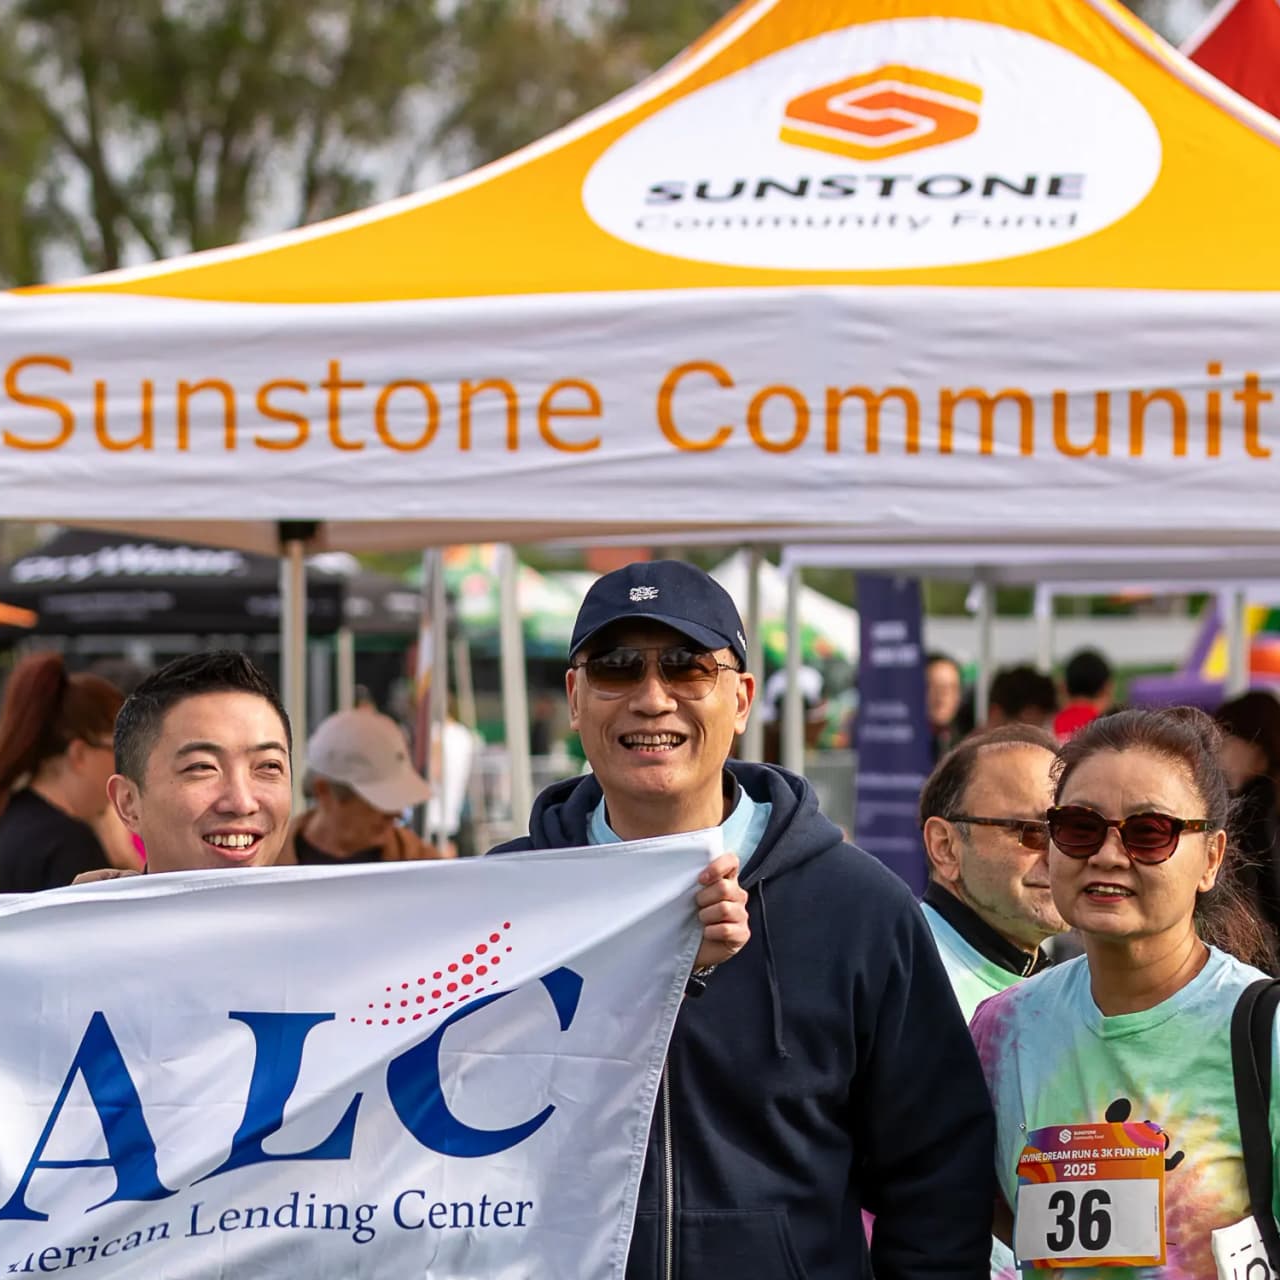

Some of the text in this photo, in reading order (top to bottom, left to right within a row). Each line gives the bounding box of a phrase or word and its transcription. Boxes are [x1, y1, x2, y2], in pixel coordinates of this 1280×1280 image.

[646, 173, 1086, 206] SUNSTONE
[635, 208, 1079, 232] Community Fund
[1, 353, 604, 454] Sunstone
[1043, 1150, 1070, 1161] DREAM
[1072, 1149, 1091, 1159] RUN
[1092, 1149, 1100, 1158] &
[1101, 1148, 1113, 1158] 3K
[1114, 1147, 1135, 1157] FUN
[1137, 1147, 1160, 1157] RUN
[1063, 1163, 1097, 1177] 2025
[184, 1191, 377, 1245] Lending
[393, 1189, 534, 1232] Center
[1046, 1188, 1112, 1253] 36
